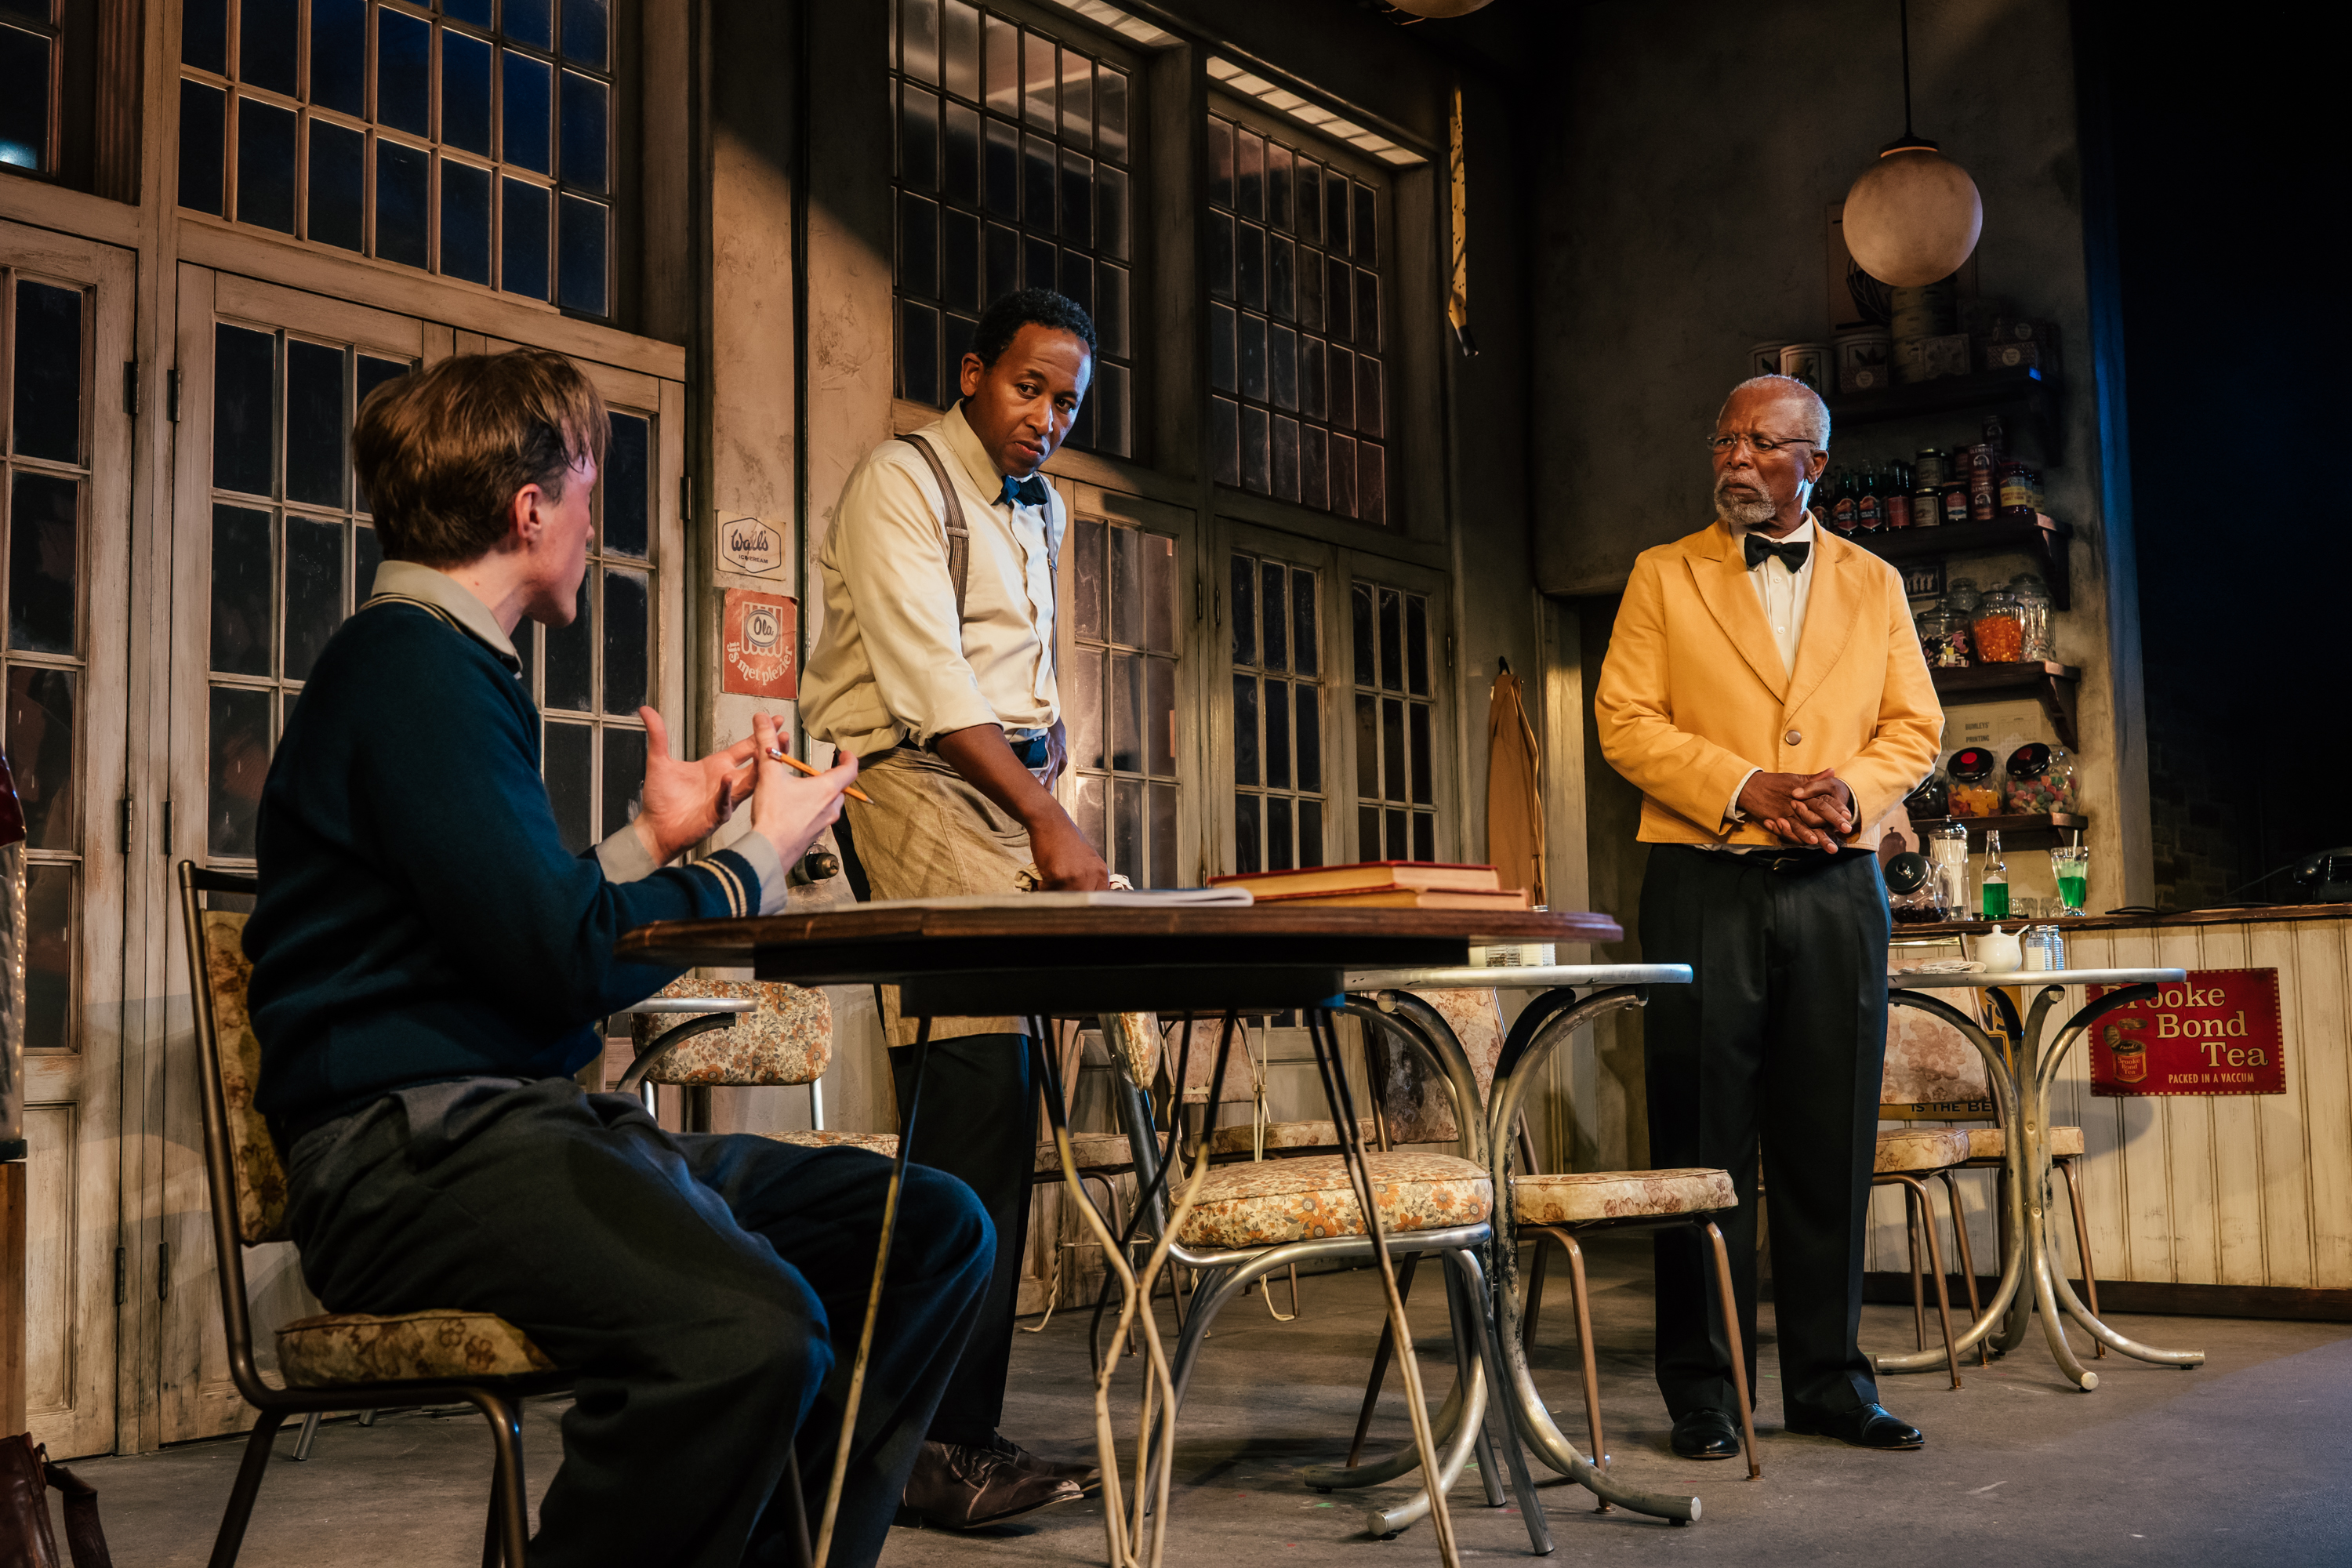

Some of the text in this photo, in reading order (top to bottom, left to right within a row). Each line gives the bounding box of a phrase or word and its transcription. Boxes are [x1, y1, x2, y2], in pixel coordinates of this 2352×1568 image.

[731, 528, 768, 551] Wall's
[753, 615, 774, 637] Ola
[727, 641, 793, 686] ijs met plezier
[1965, 735, 1990, 743] PRINTING
[2156, 1011, 2249, 1039] Bond
[2200, 1041, 2269, 1067] Tea
[2168, 1073, 2255, 1084] PACKED IN A VACCUM
